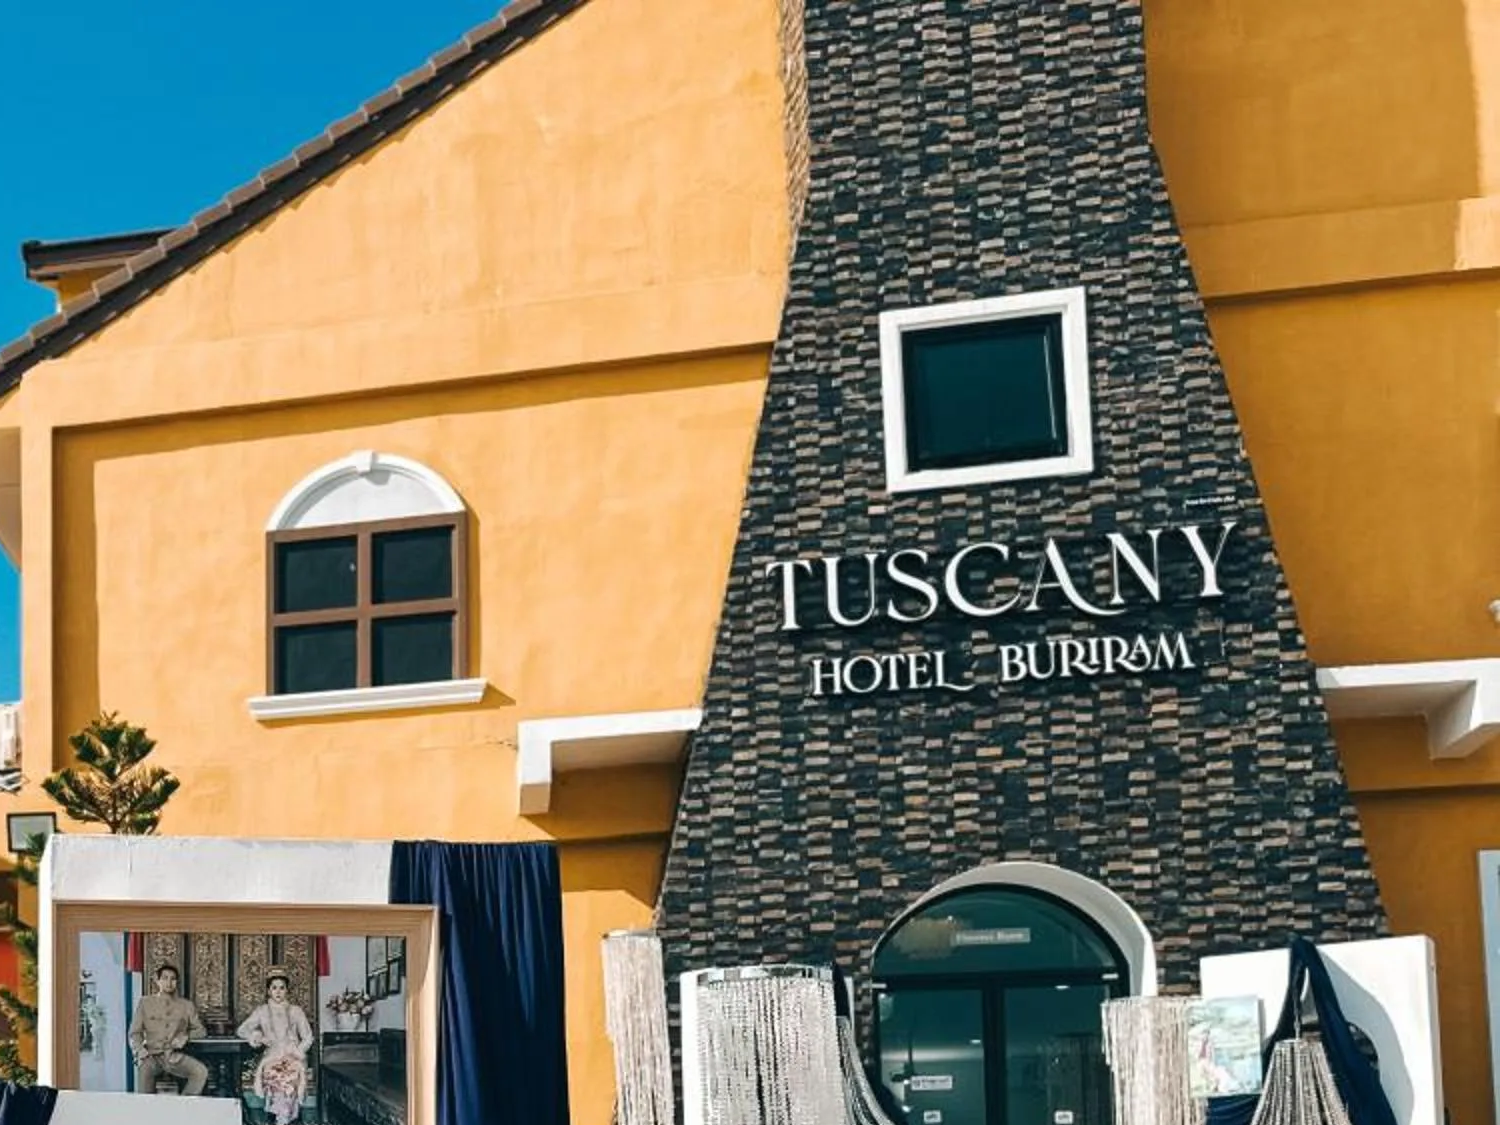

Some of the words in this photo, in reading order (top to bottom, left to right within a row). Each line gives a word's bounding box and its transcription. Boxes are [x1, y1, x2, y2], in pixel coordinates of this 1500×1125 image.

[765, 521, 1237, 631] TUSCANY
[811, 650, 974, 696] HOTEL
[1000, 632, 1195, 683] BURIRAM
